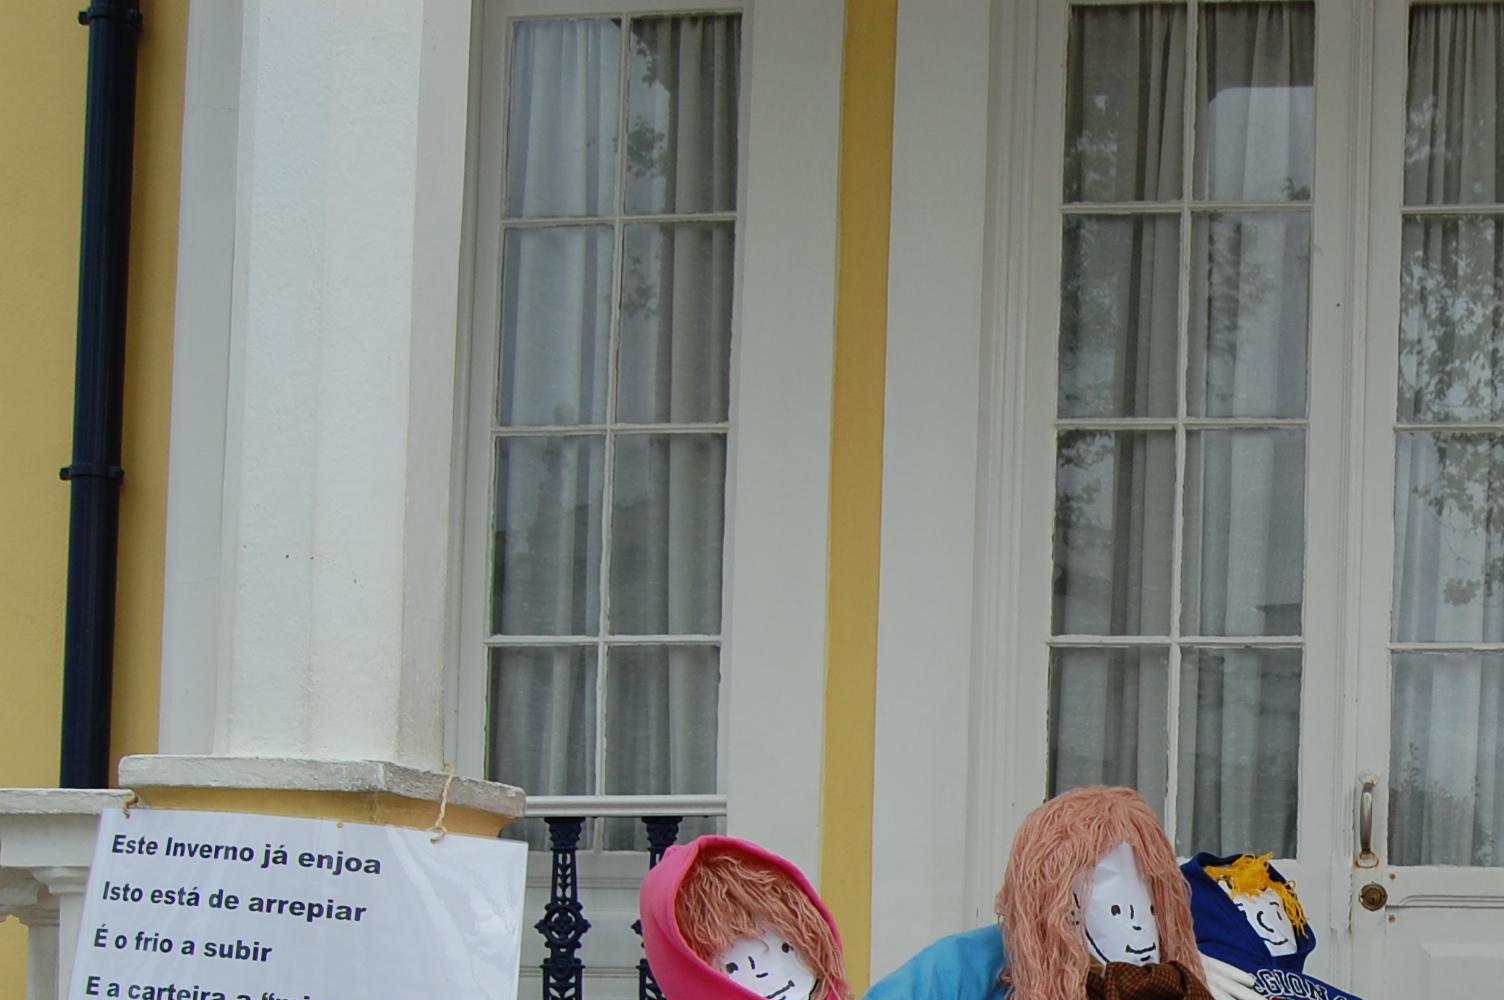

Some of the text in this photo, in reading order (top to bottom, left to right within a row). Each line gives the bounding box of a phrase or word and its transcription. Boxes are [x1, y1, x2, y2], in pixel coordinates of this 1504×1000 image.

[112, 834, 381, 876] Este Inverno já enjoa
[102, 881, 367, 922] Isto está de arrepiar
[93, 923, 272, 962] É o frio a subir
[86, 976, 101, 996] E
[107, 982, 120, 998] a
